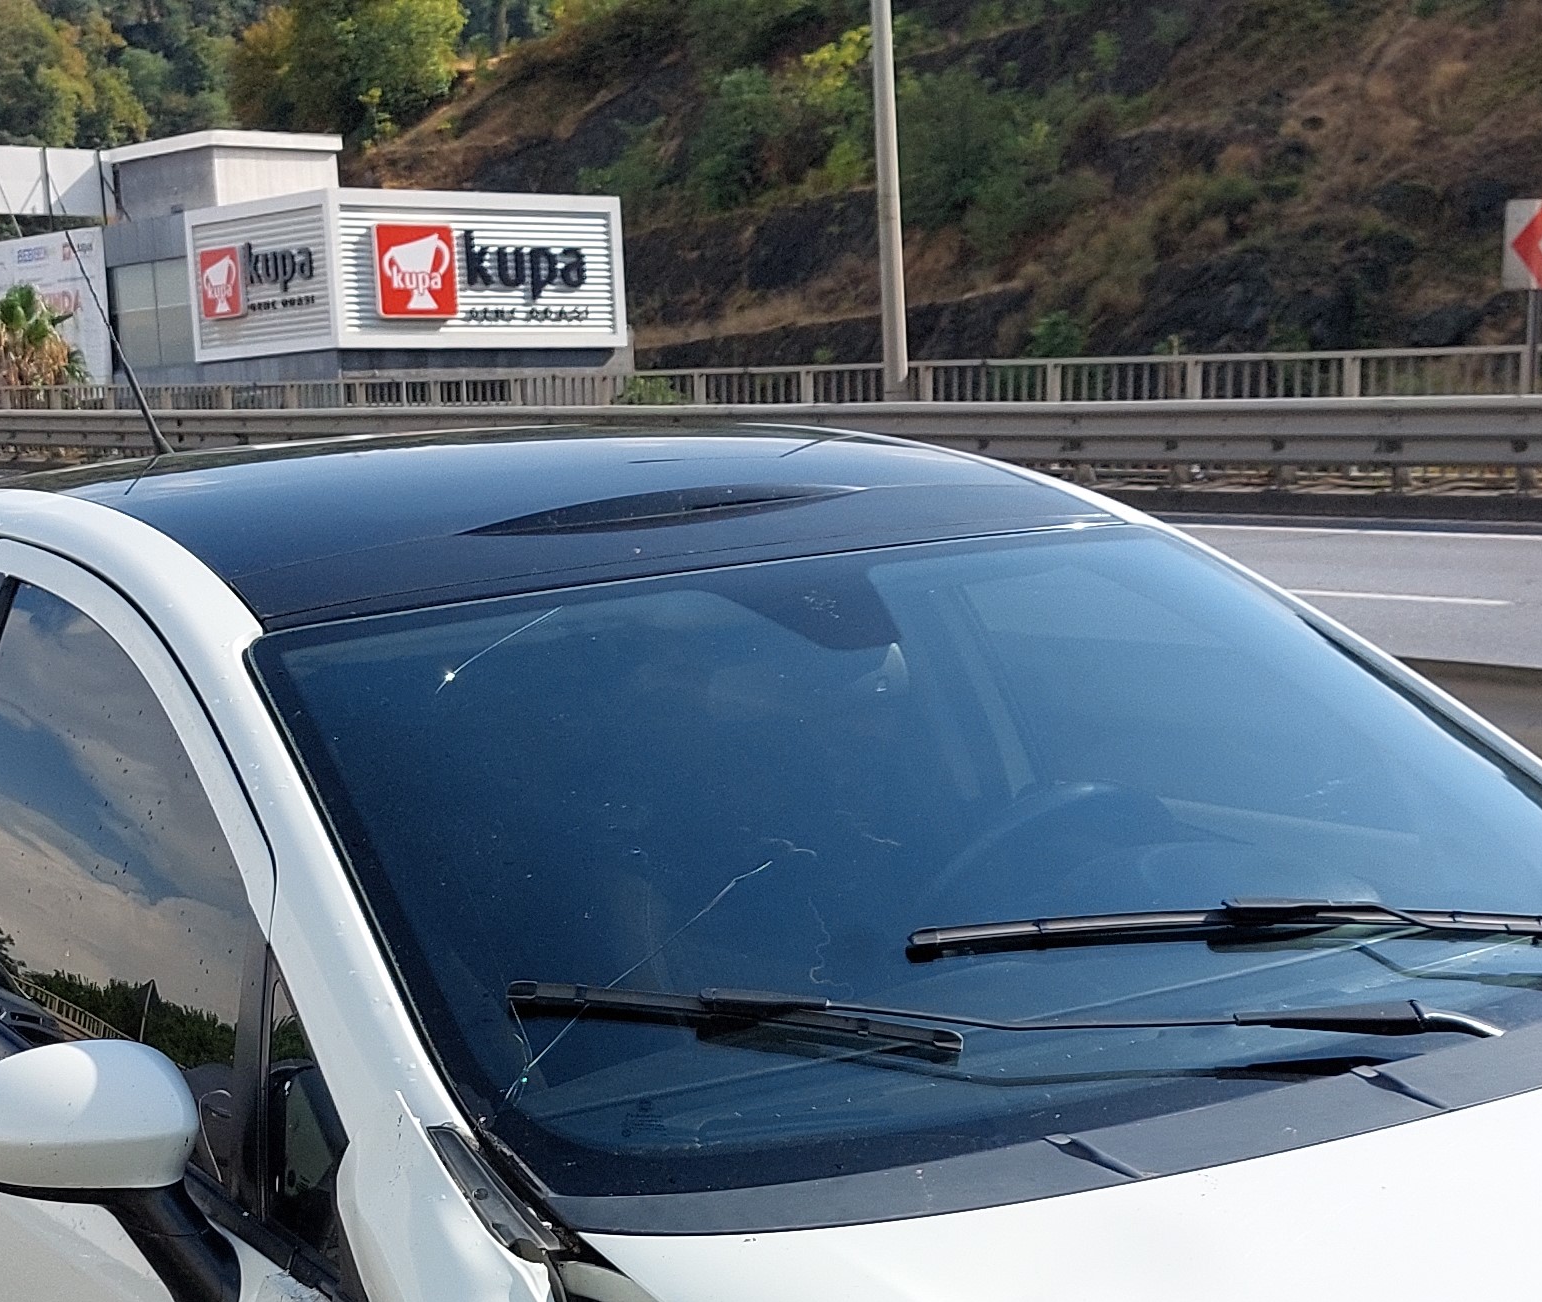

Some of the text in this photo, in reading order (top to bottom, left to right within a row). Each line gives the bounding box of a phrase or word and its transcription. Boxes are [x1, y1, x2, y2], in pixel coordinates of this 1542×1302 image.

[244, 242, 314, 292] kupa
[392, 265, 443, 296] kupa
[462, 230, 588, 301] kupa
[207, 284, 234, 301] kupa
